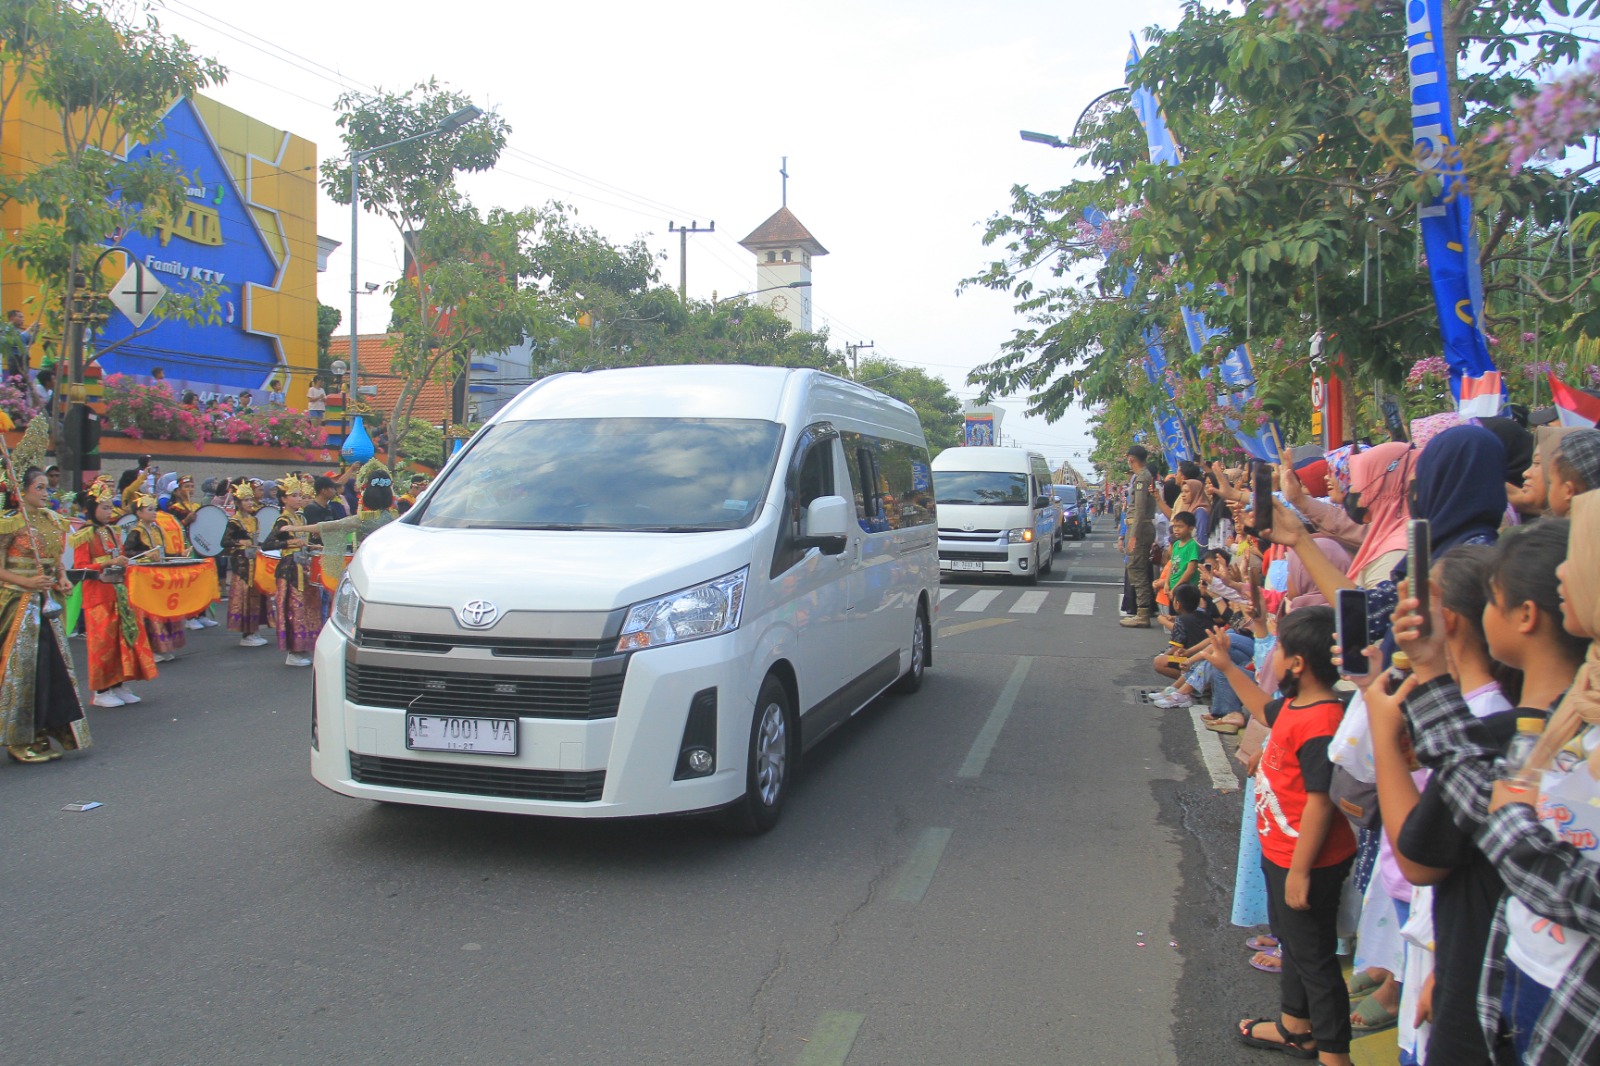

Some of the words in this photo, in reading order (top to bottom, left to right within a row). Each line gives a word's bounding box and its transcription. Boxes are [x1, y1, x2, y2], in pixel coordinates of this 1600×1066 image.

[145, 255, 189, 279] Family
[190, 266, 225, 284] KTV
[151, 571, 200, 590] SMP
[166, 592, 180, 611] 6
[408, 716, 429, 738] AE
[440, 718, 479, 740] 7001
[491, 720, 512, 741] VA
